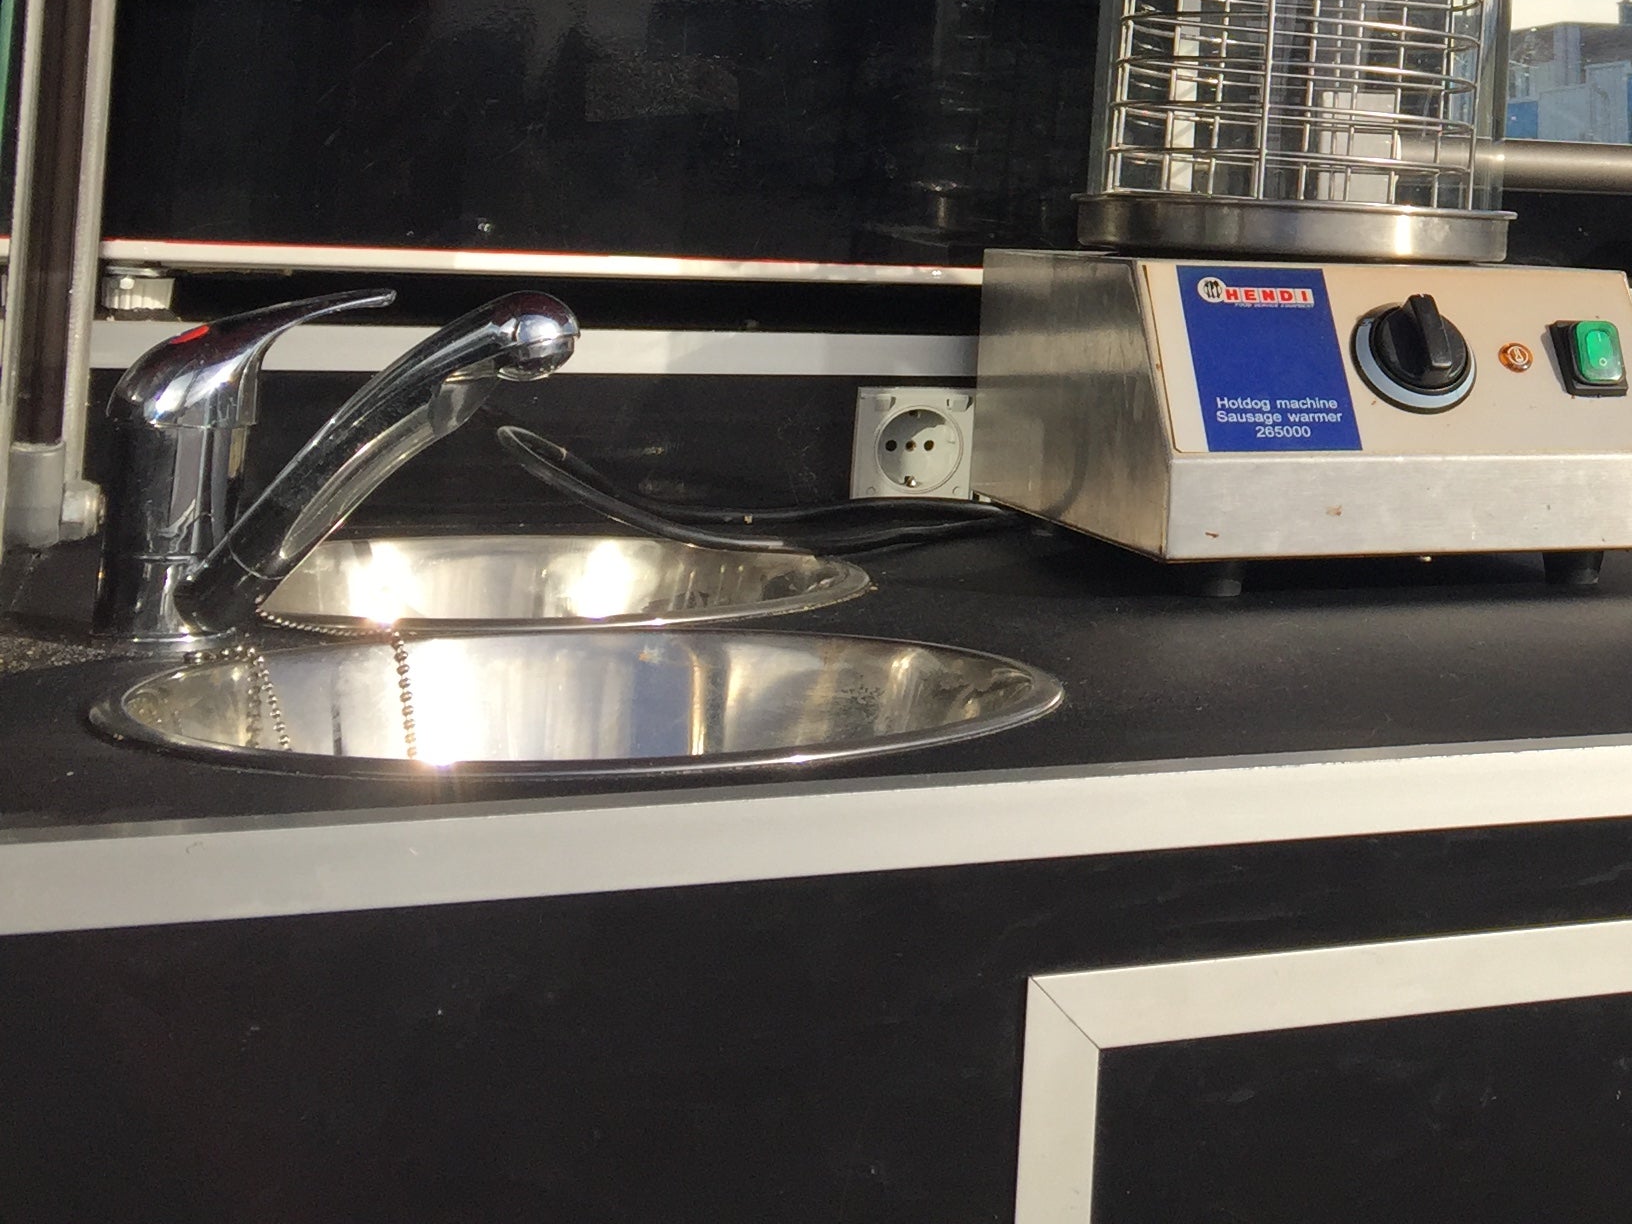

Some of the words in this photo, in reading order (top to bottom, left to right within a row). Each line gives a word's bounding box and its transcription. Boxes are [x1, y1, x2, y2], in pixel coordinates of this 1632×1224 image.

[1226, 289, 1308, 302] HENDI
[1217, 397, 1270, 411] Hotdog
[1276, 397, 1338, 408] machine
[1216, 411, 1282, 424] Sausage
[1288, 412, 1342, 422] warmer
[1255, 426, 1311, 438] 265000
